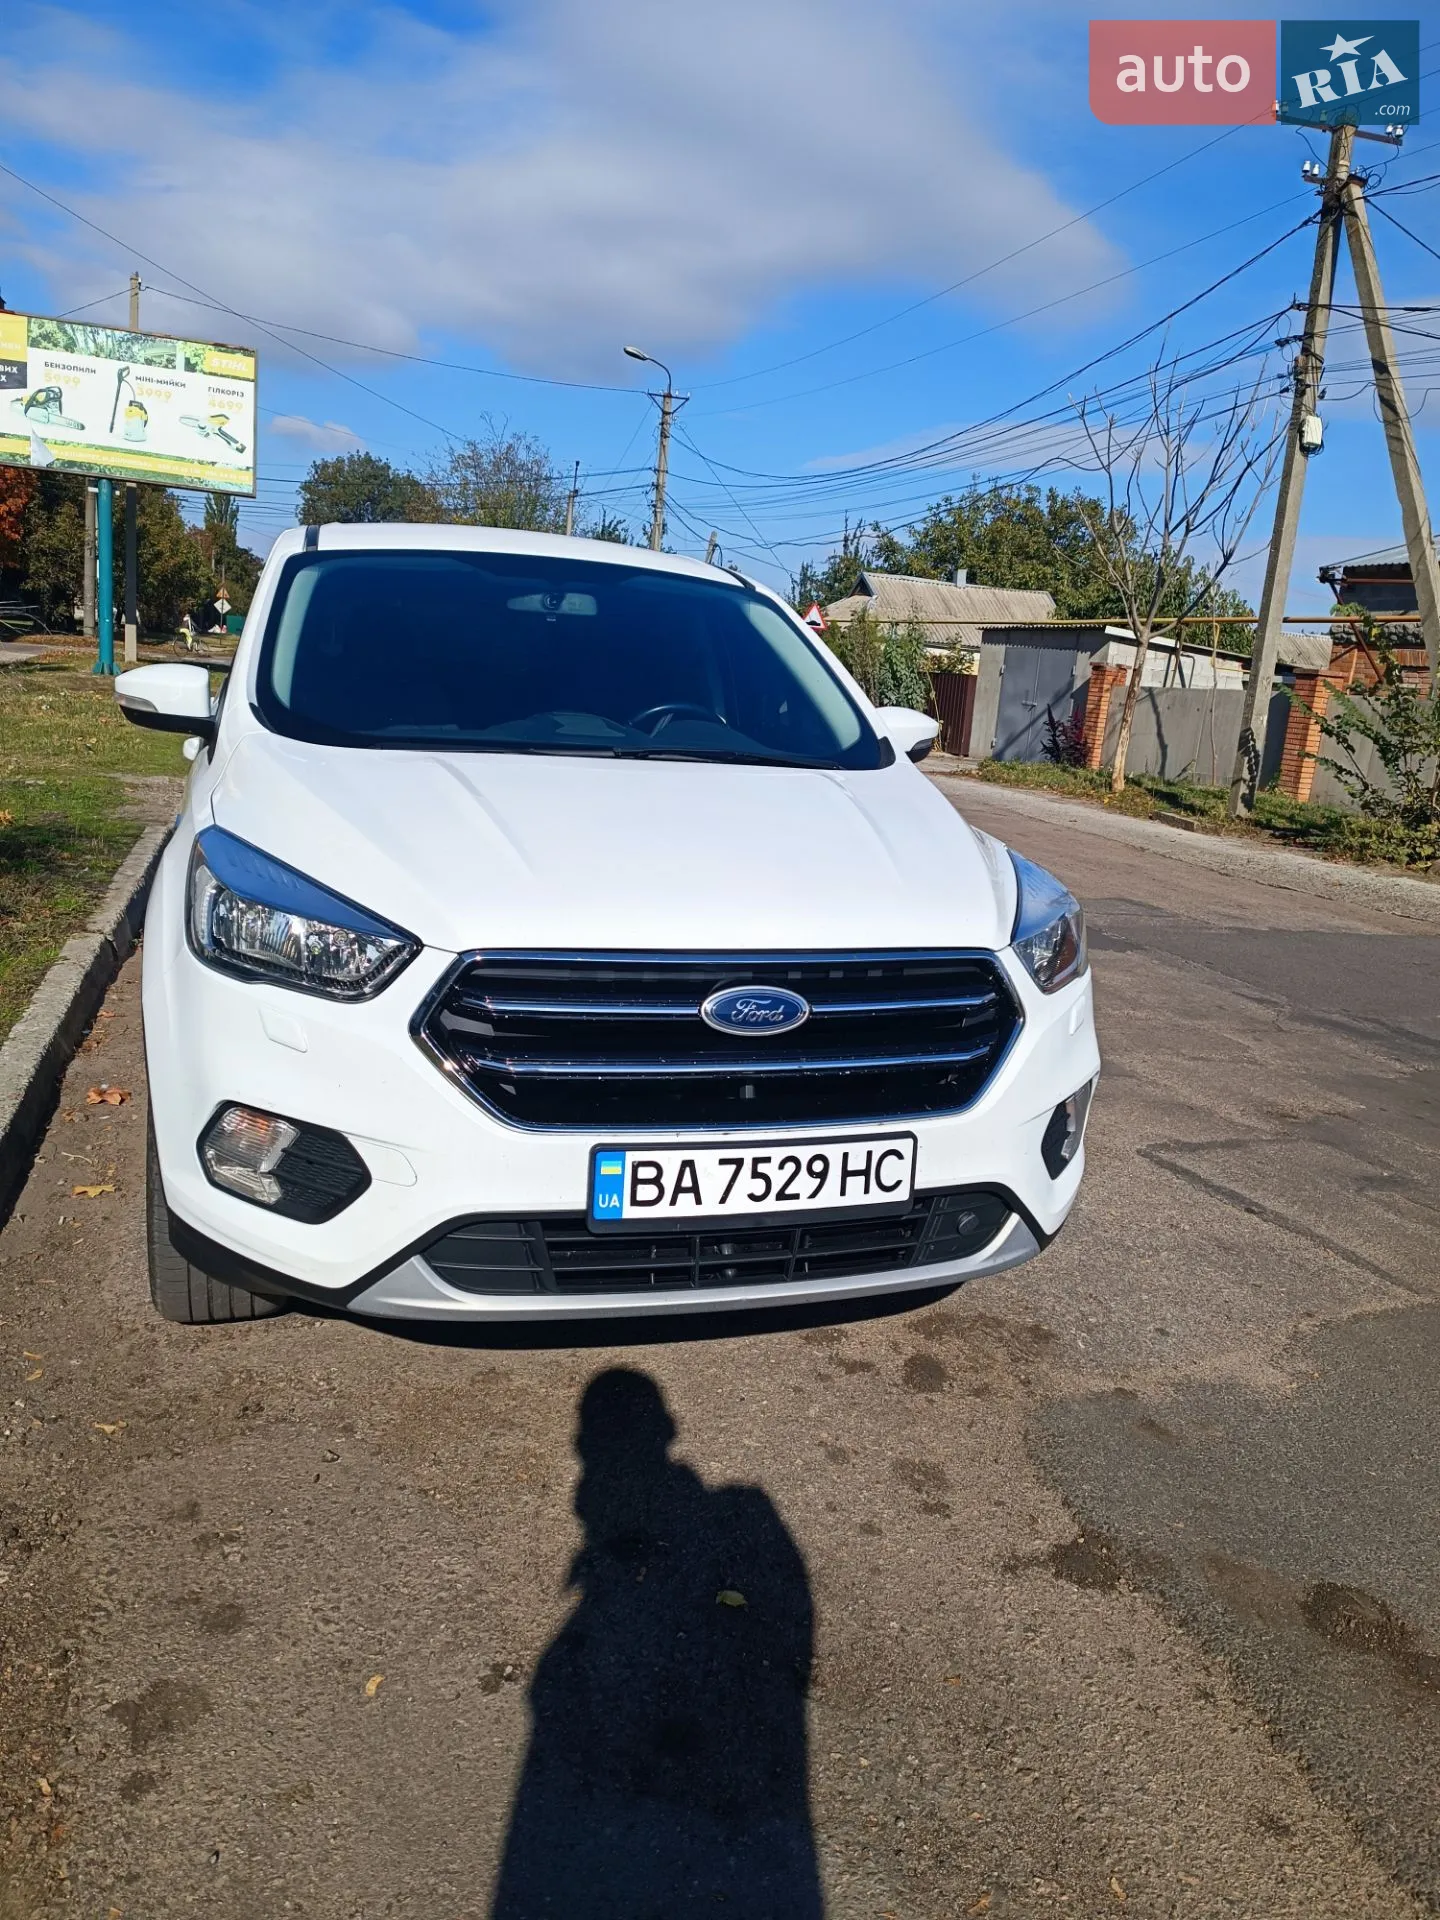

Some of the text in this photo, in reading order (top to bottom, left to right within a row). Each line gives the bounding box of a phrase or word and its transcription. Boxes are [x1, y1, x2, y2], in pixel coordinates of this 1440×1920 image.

[44, 361, 97, 375] БЕНЗОПИЛИ
[135, 376, 186, 389] МІНІ-МИЙКИ
[207, 386, 245, 398] ГІЛКОРІЗ
[731, 998, 785, 1022] Ford
[630, 1149, 905, 1207] BA 7529 HC
[598, 1193, 620, 1208] UA
